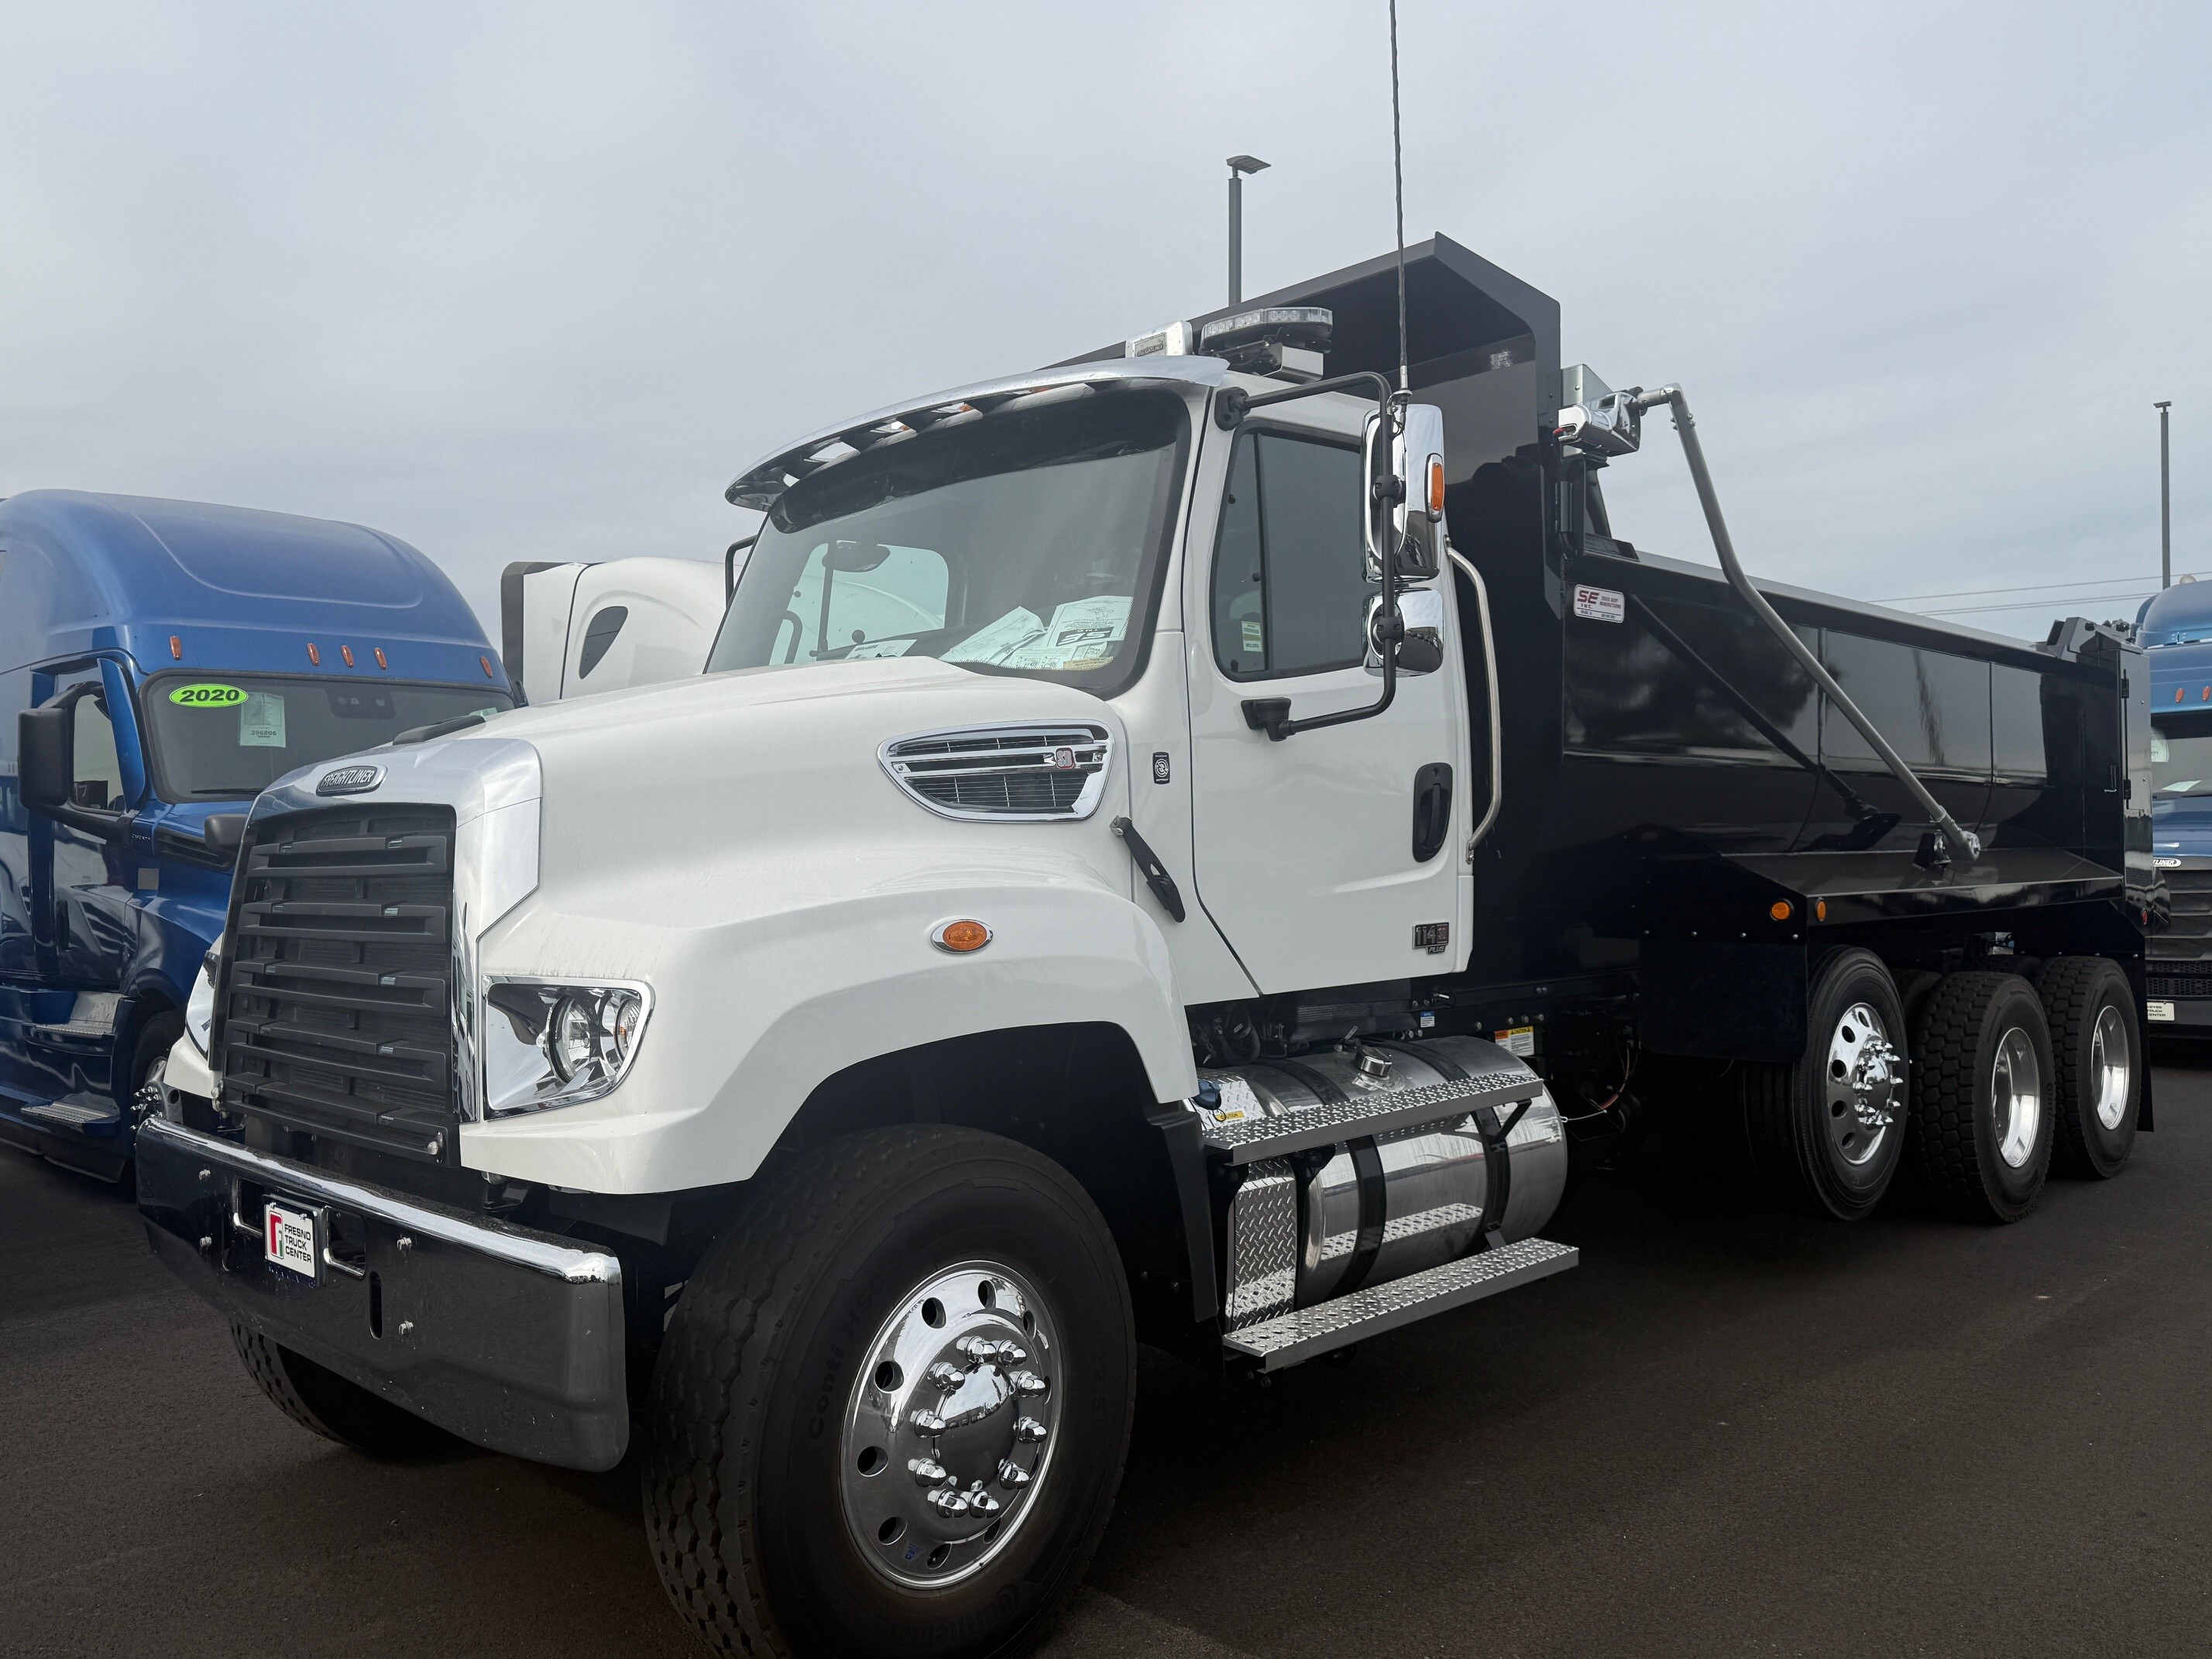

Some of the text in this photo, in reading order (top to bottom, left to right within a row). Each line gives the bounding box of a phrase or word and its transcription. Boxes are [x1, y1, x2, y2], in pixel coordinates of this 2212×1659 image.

[1577, 589, 1599, 604] SE
[180, 689, 239, 702] 2020
[1056, 750, 1072, 766] SD
[320, 769, 375, 788] FREIGHTLINER
[1417, 925, 1436, 945] 114
[284, 1223, 311, 1241] FRESNO
[285, 1235, 307, 1251] TRUCK
[285, 1245, 311, 1263] CENTER
